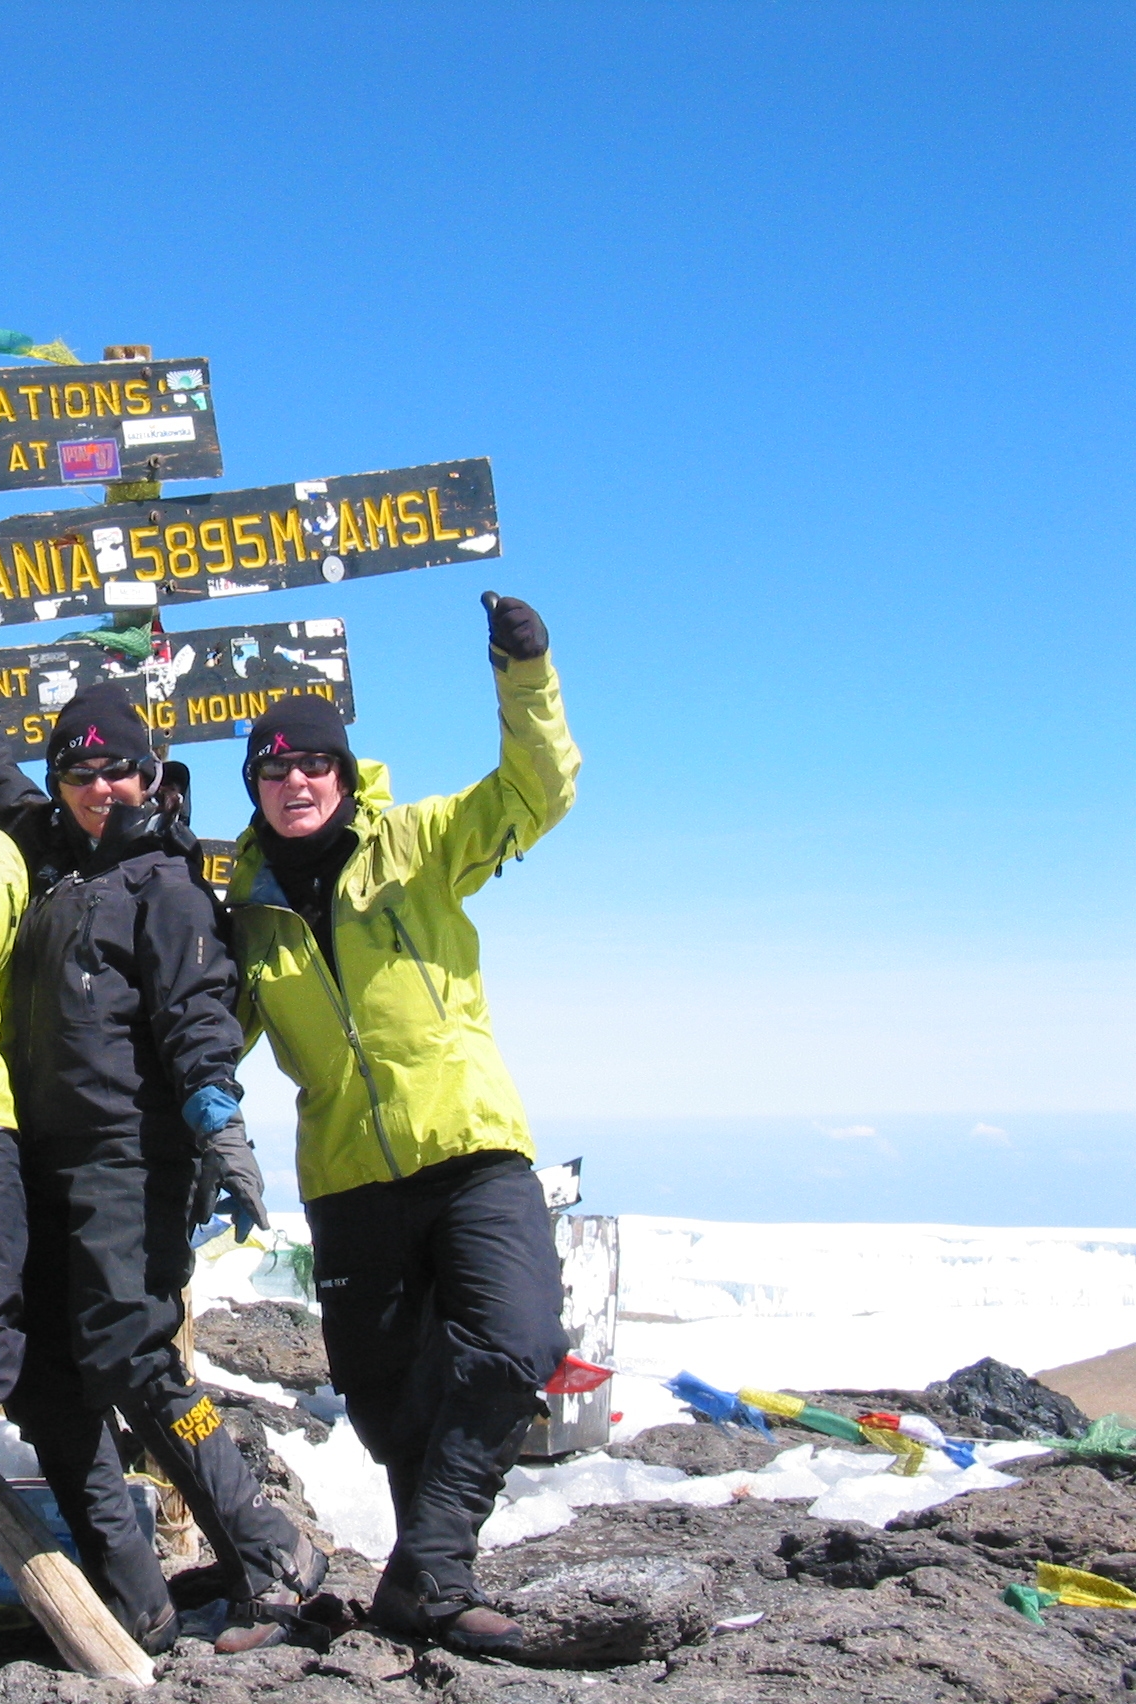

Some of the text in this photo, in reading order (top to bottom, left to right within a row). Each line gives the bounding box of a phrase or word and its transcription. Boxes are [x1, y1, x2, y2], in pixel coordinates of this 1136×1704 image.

[8, 440, 49, 472] AT
[338, 487, 476, 556] AMSL.
[187, 683, 335, 727] MOUNTN
[68, 735, 84, 749] 07
